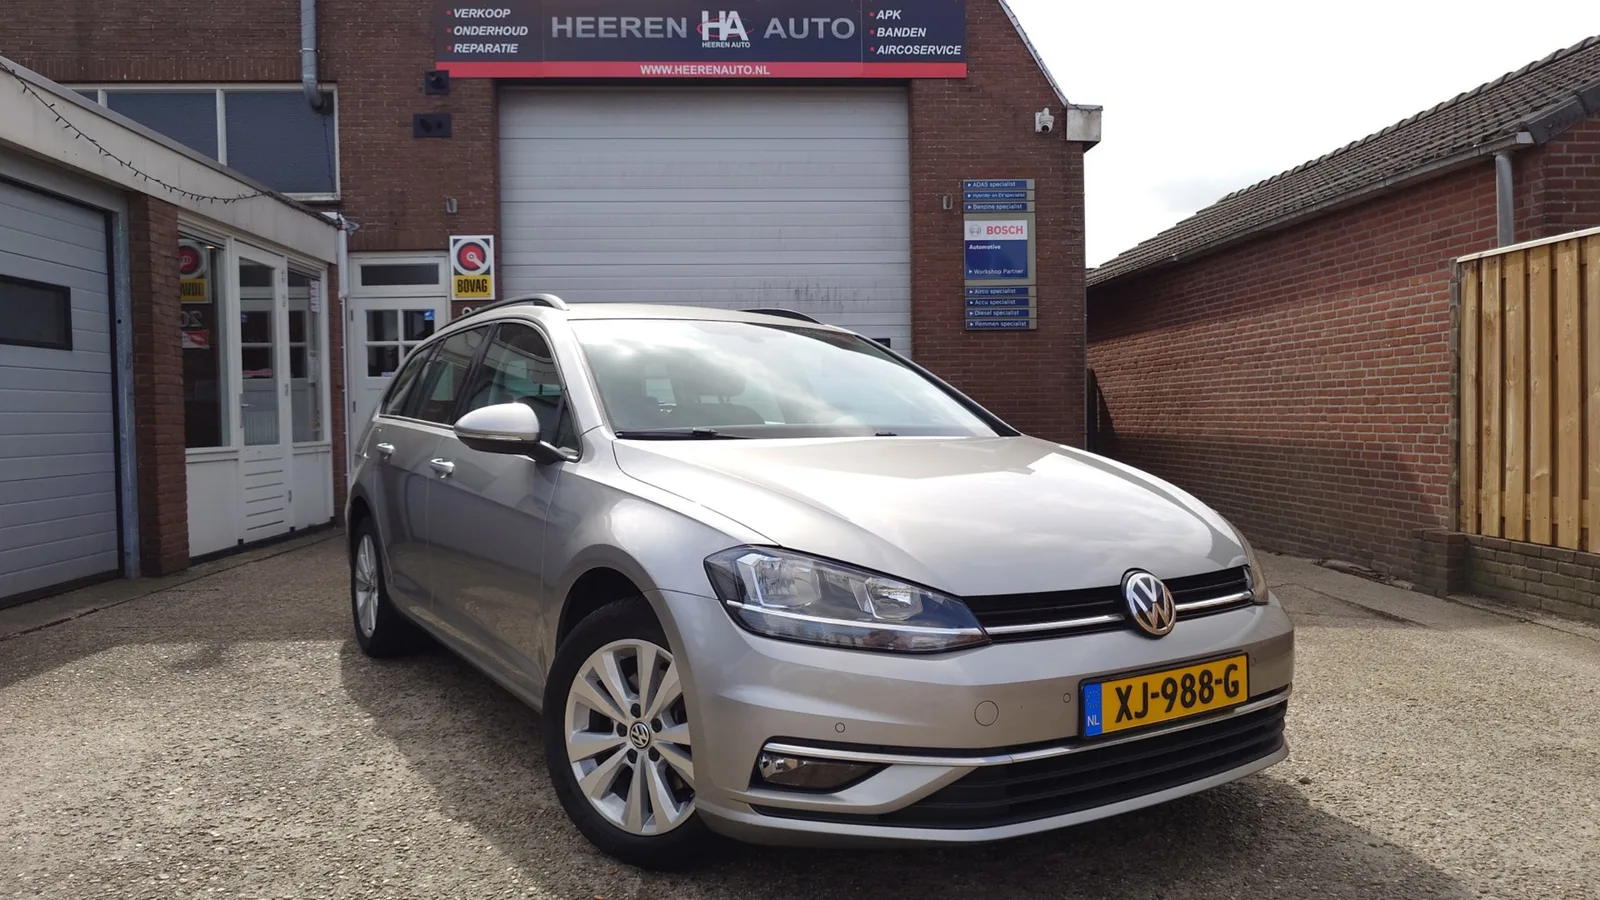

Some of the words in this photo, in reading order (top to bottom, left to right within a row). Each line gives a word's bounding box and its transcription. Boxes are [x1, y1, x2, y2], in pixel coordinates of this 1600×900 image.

[453, 8, 511, 18] VERKOOP
[876, 10, 901, 20] APK
[551, 17, 688, 39] HEEREN
[702, 10, 749, 41] HA
[763, 17, 855, 39] AUTO
[453, 26, 528, 36] ONDERHOUD
[876, 27, 927, 38] BANDEN
[453, 43, 519, 53] REPARATIE
[876, 45, 962, 55] AIRCOSERVICE
[640, 65, 770, 75] WWW.HEERENAUTO.NL
[986, 226, 1023, 235] BOSCH
[458, 279, 488, 293] BOVAG
[1114, 663, 1240, 724] XJ-988-G
[1087, 714, 1100, 727] NL
